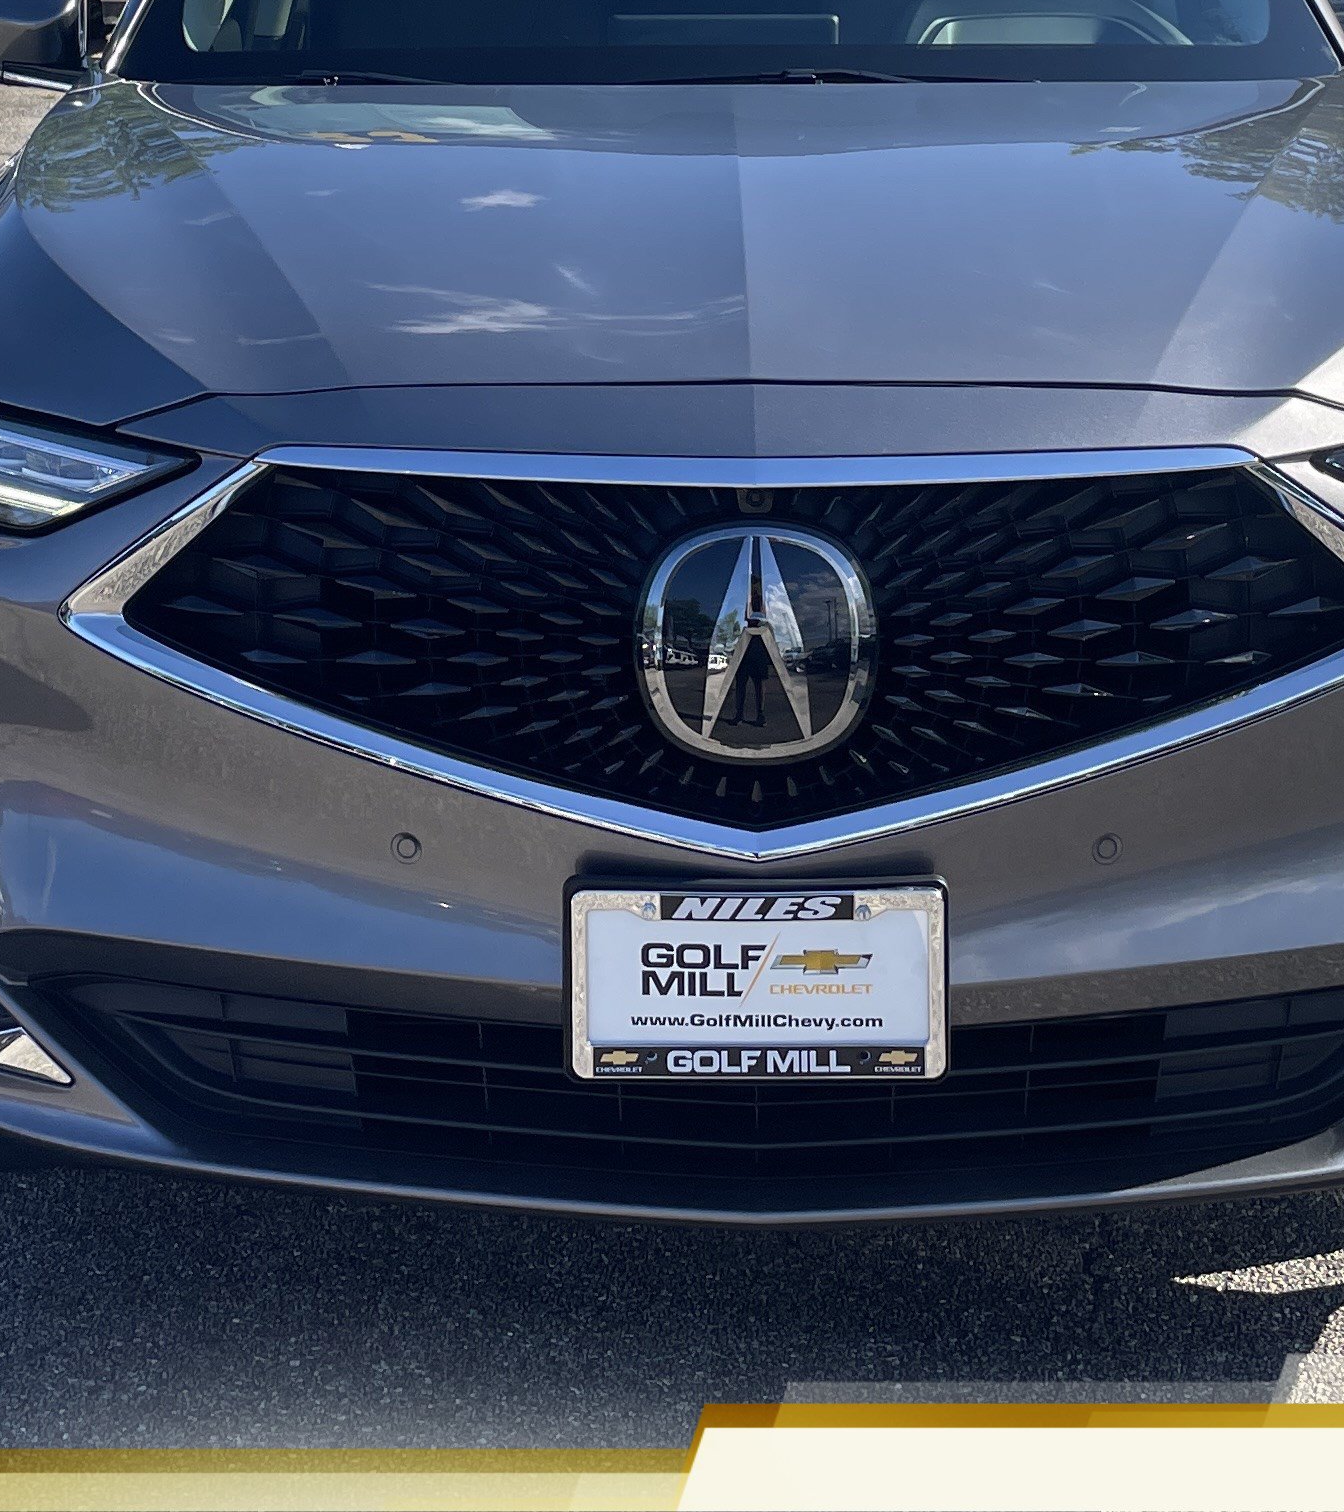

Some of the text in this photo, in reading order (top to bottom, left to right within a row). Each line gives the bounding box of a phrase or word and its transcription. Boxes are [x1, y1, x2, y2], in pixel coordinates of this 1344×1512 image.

[672, 896, 843, 920] NILES
[641, 942, 767, 970] GOLF
[641, 970, 744, 997] MILL
[769, 984, 874, 995] CHEVROLET
[630, 1012, 884, 1031] www.GolfMillChevy.com
[666, 1050, 852, 1074] GOLF MILL
